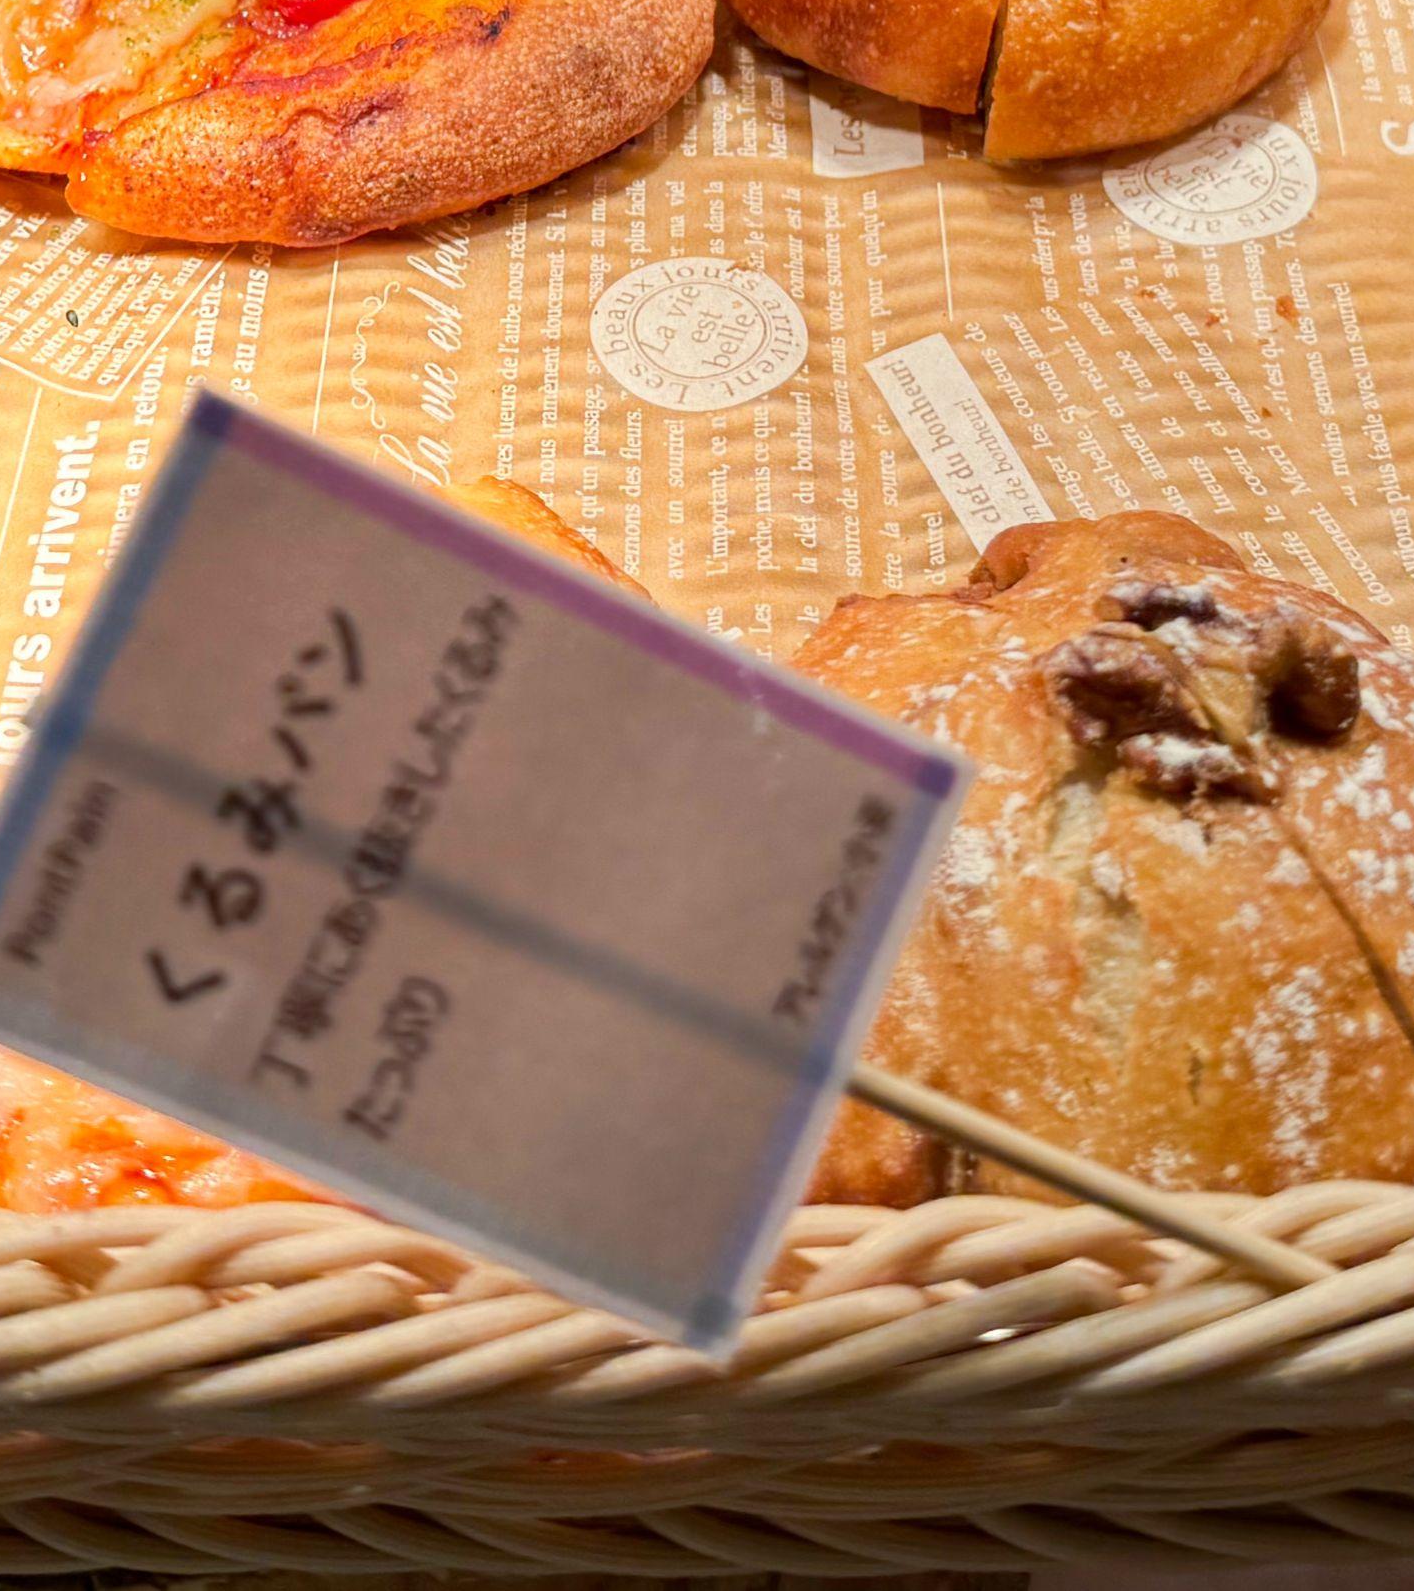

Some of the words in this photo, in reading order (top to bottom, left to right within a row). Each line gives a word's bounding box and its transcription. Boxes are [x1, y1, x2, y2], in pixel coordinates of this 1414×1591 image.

[710, 102, 735, 157] passage,
[766, 122, 787, 159] Merci
[834, 118, 865, 157] Les
[624, 179, 646, 216] facile
[1238, 176, 1308, 227] jours
[23, 217, 89, 273] bonheur
[624, 220, 649, 254] plus
[821, 233, 842, 286] sourire
[23, 265, 76, 309] source
[94, 275, 145, 324] source
[236, 270, 268, 338] moins
[506, 262, 526, 300] nous
[539, 249, 565, 340] doucement.
[866, 278, 889, 317] pour
[407, 288, 463, 353] est
[600, 275, 654, 355] beaux
[639, 327, 674, 358] La
[666, 285, 702, 318] vie
[688, 309, 724, 343] est
[825, 290, 843, 331] votre
[964, 321, 991, 343] de
[1001, 312, 1043, 358] aimez
[1079, 301, 1114, 338] nous
[1327, 282, 1363, 343] sourire!
[72, 312, 132, 380] bonheur
[229, 344, 256, 373] au
[496, 358, 519, 379] de
[827, 337, 847, 375] mais
[411, 360, 459, 424] vie
[536, 346, 561, 429] ramènent
[625, 363, 690, 404] Les
[831, 379, 853, 433] sourire
[885, 358, 948, 451] bonheur!
[986, 347, 1036, 418] couleurs
[1039, 362, 1067, 403] vous
[1104, 396, 1126, 418] en
[1303, 352, 1337, 416] semons
[1355, 371, 1376, 410] avec
[494, 384, 518, 439] lueurs
[580, 384, 605, 455] passage,
[618, 408, 642, 461] fleurs.
[791, 391, 814, 472] bonheur!
[959, 396, 1013, 474] bonheur!
[123, 439, 152, 470] en
[664, 420, 685, 487] sourire!
[836, 439, 857, 482] votre
[1029, 424, 1054, 449] les
[1119, 423, 1166, 480] aimera
[1320, 423, 1351, 477] moins
[1365, 413, 1396, 460] facile
[379, 434, 452, 489] La
[538, 440, 556, 483] nous
[619, 466, 642, 496] des
[878, 450, 898, 506] source
[944, 453, 974, 480] du
[1188, 456, 1236, 514] lueurs
[1267, 443, 1313, 496] Merci
[1376, 463, 1409, 503] plus
[576, 466, 600, 519] qu'un
[668, 500, 683, 524] un
[749, 465, 772, 514] mais
[794, 481, 816, 503] du
[836, 486, 858, 510] de
[960, 483, 1004, 524] clef
[1004, 478, 1034, 501] de
[22, 420, 102, 617] arrivent.
[623, 500, 642, 576] semons
[794, 515, 818, 548] clef
[669, 540, 684, 579] avec
[841, 515, 863, 577] source
[147, 607, 370, 1013] くるみパン
